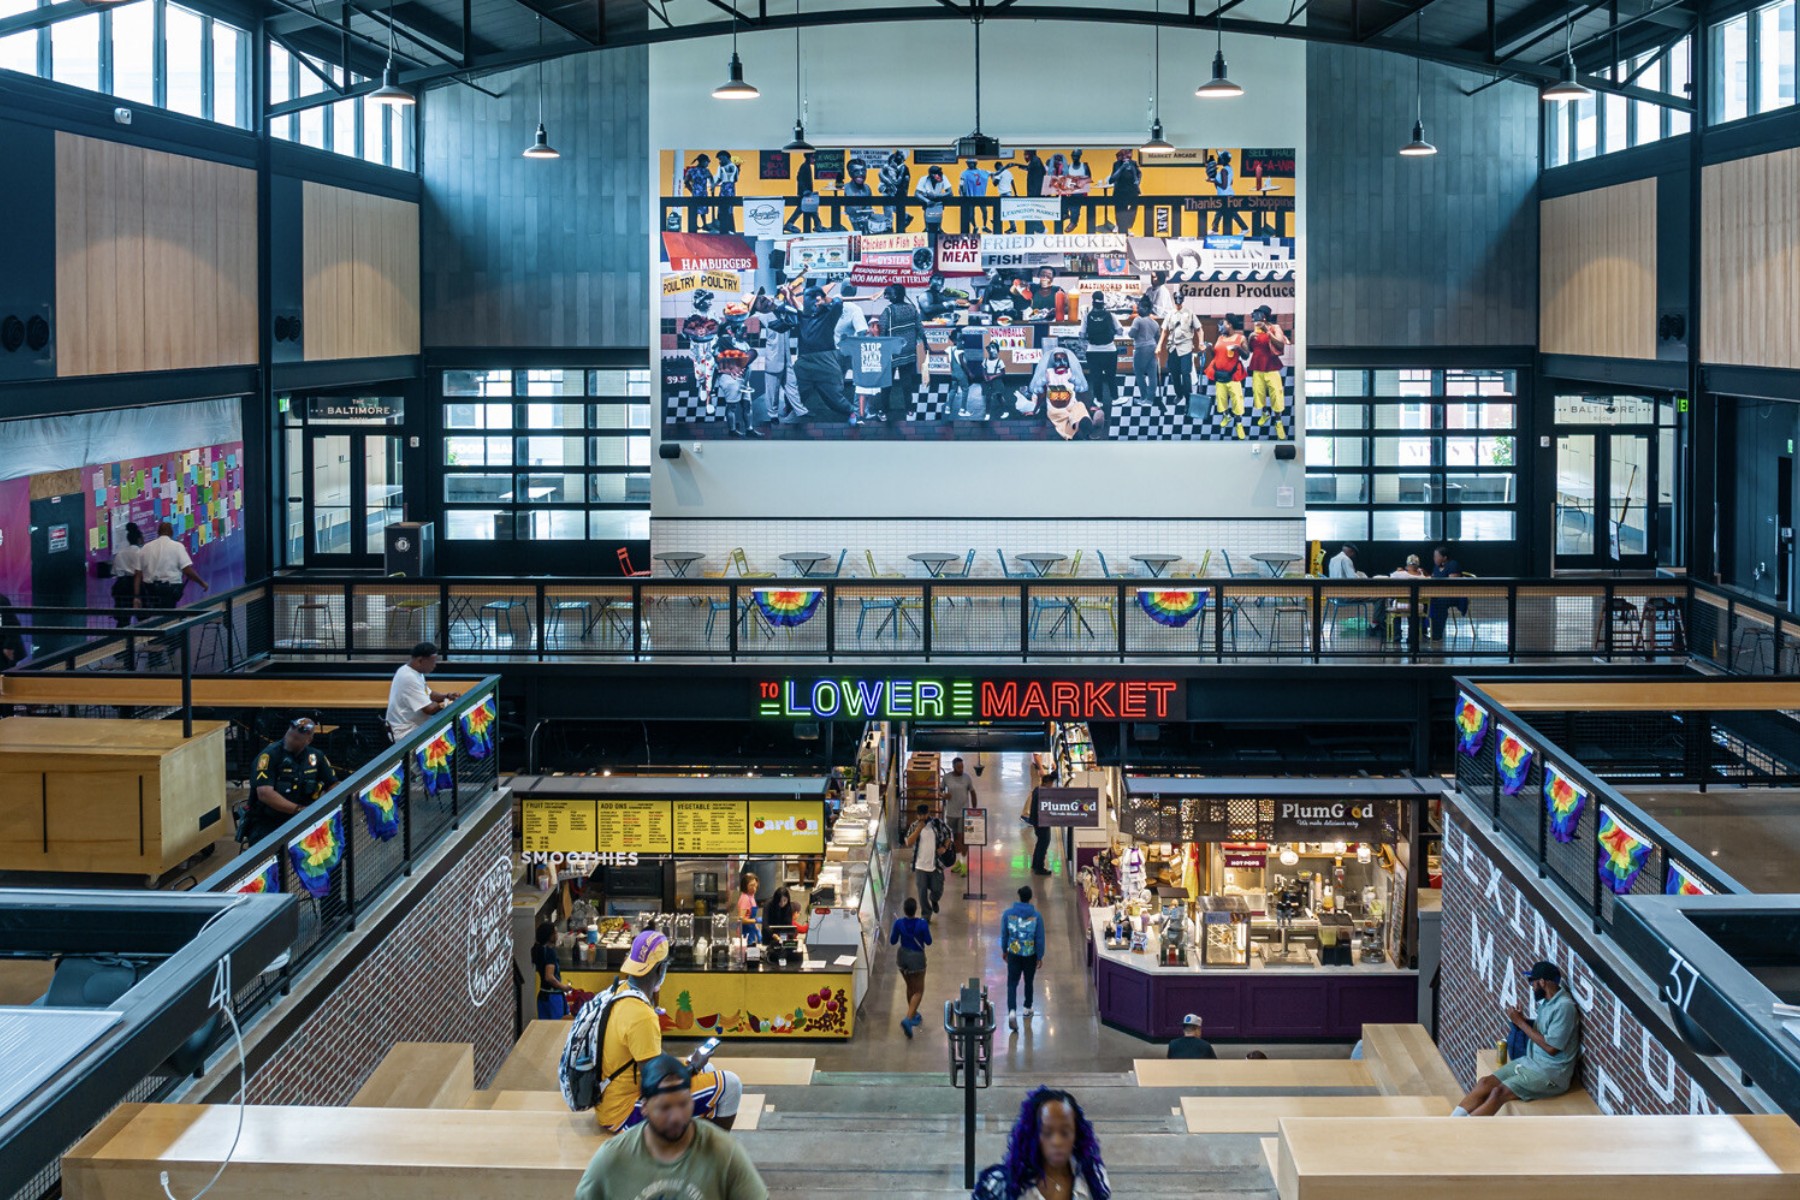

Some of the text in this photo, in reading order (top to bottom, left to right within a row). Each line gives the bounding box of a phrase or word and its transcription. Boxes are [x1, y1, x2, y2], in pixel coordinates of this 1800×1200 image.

[1272, 148, 1295, 157] TRAD
[1184, 197, 1223, 210] Thanks
[1227, 198, 1243, 208] For
[862, 238, 887, 250] Chicken
[896, 236, 910, 247] Fish
[913, 235, 925, 247] Sub
[942, 240, 979, 250] CRAB
[983, 234, 1126, 250] FRIED CHICKEN
[942, 251, 979, 263] MEAT
[988, 254, 1023, 265] FISH
[681, 258, 752, 270] HAMBURGERS
[1138, 260, 1172, 271] PARKS
[850, 273, 865, 282] HOG
[663, 276, 695, 294] POULTRY
[701, 275, 738, 291] POULTRY
[1179, 283, 1295, 297] Garden Produce
[990, 328, 1026, 337] SNOWBALLS
[861, 342, 882, 352] STOP
[327, 407, 390, 415] BALTIMORE
[1571, 405, 1635, 413] BALTIORE
[760, 680, 1177, 718] TO LOWER MARKET
[754, 815, 819, 834] gardn
[521, 850, 639, 866] SMOOTHIES
[1665, 948, 1700, 1013] 37
